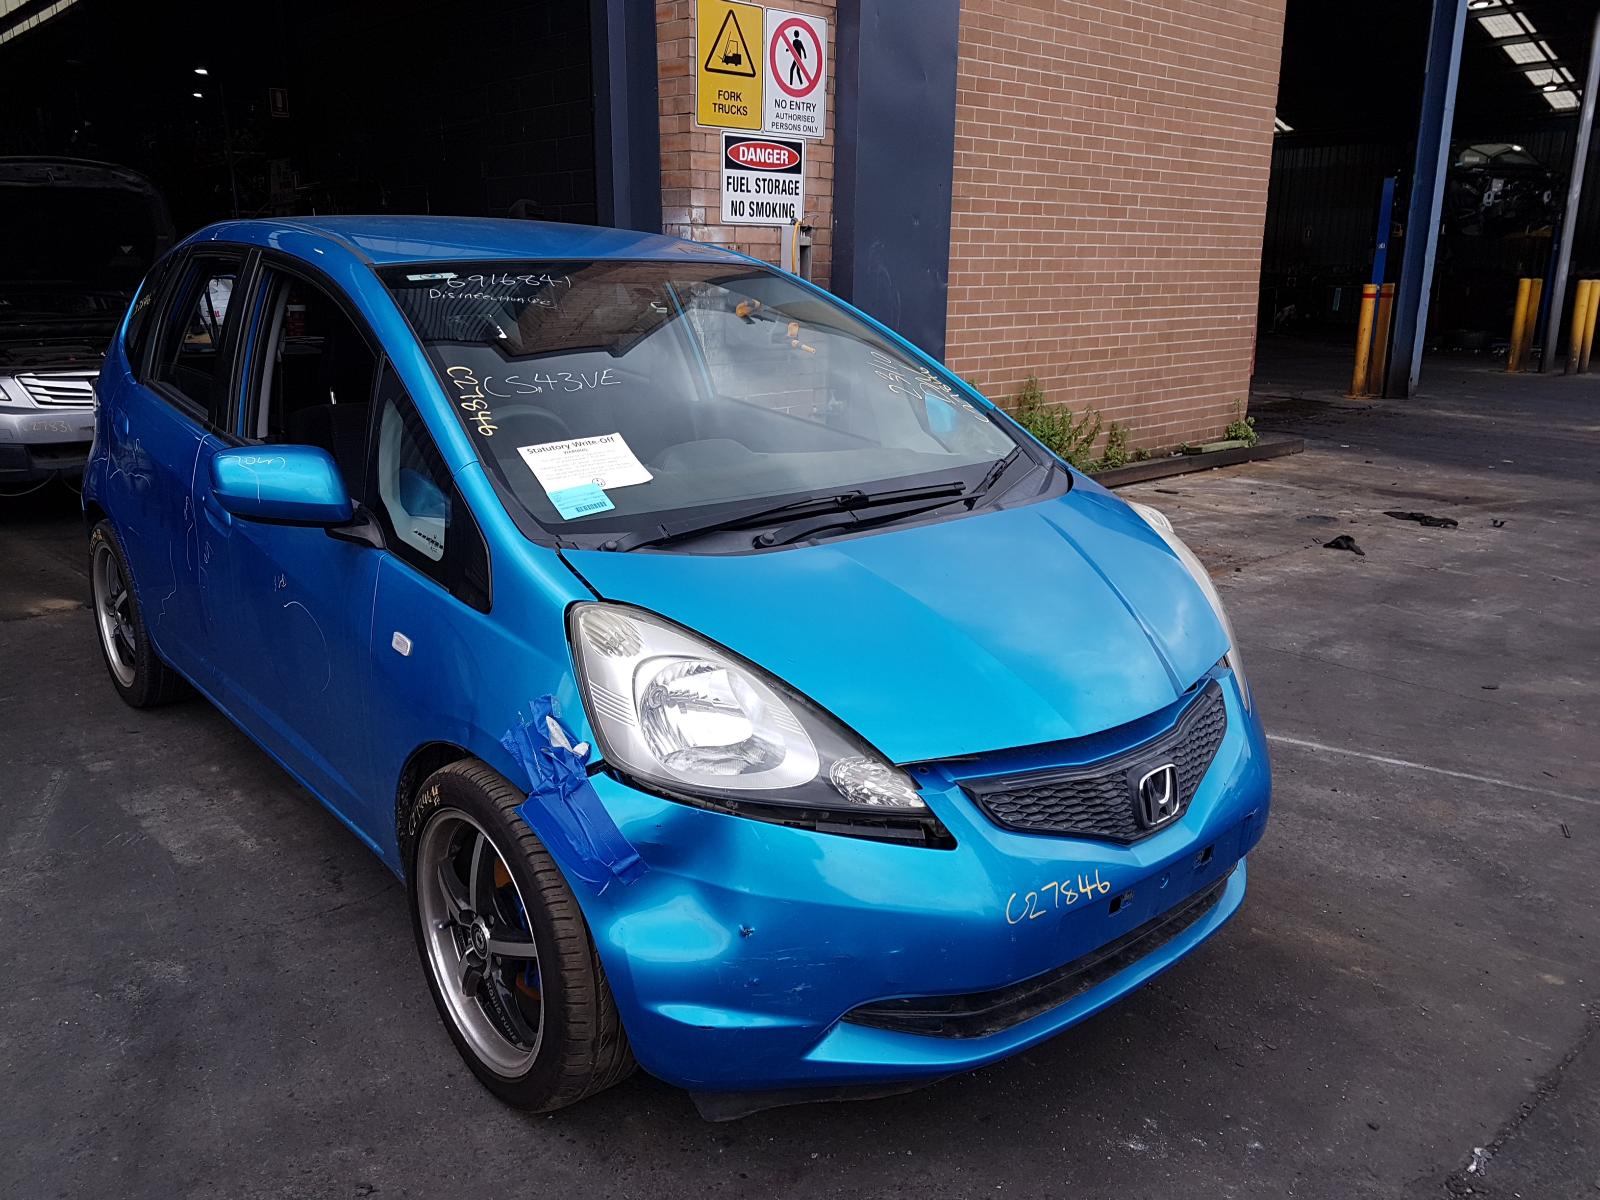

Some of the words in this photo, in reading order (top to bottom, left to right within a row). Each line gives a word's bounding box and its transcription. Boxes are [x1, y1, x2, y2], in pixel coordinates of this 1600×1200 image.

[717, 90, 743, 102] FORK
[712, 103, 748, 116] TRUCKS
[774, 99, 788, 109] NO
[789, 101, 817, 113] ENTRY
[775, 112, 816, 123] AUTHORISED
[771, 121, 801, 132] PERSONS
[802, 125, 819, 134] ONLY
[739, 146, 789, 165] DANGER
[726, 175, 752, 193] FUEL
[754, 178, 800, 196] STORAGE
[730, 200, 745, 217] NO
[748, 201, 796, 219] SMOKING
[526, 442, 570, 455] Statutory
[571, 435, 615, 448] Write-Off
